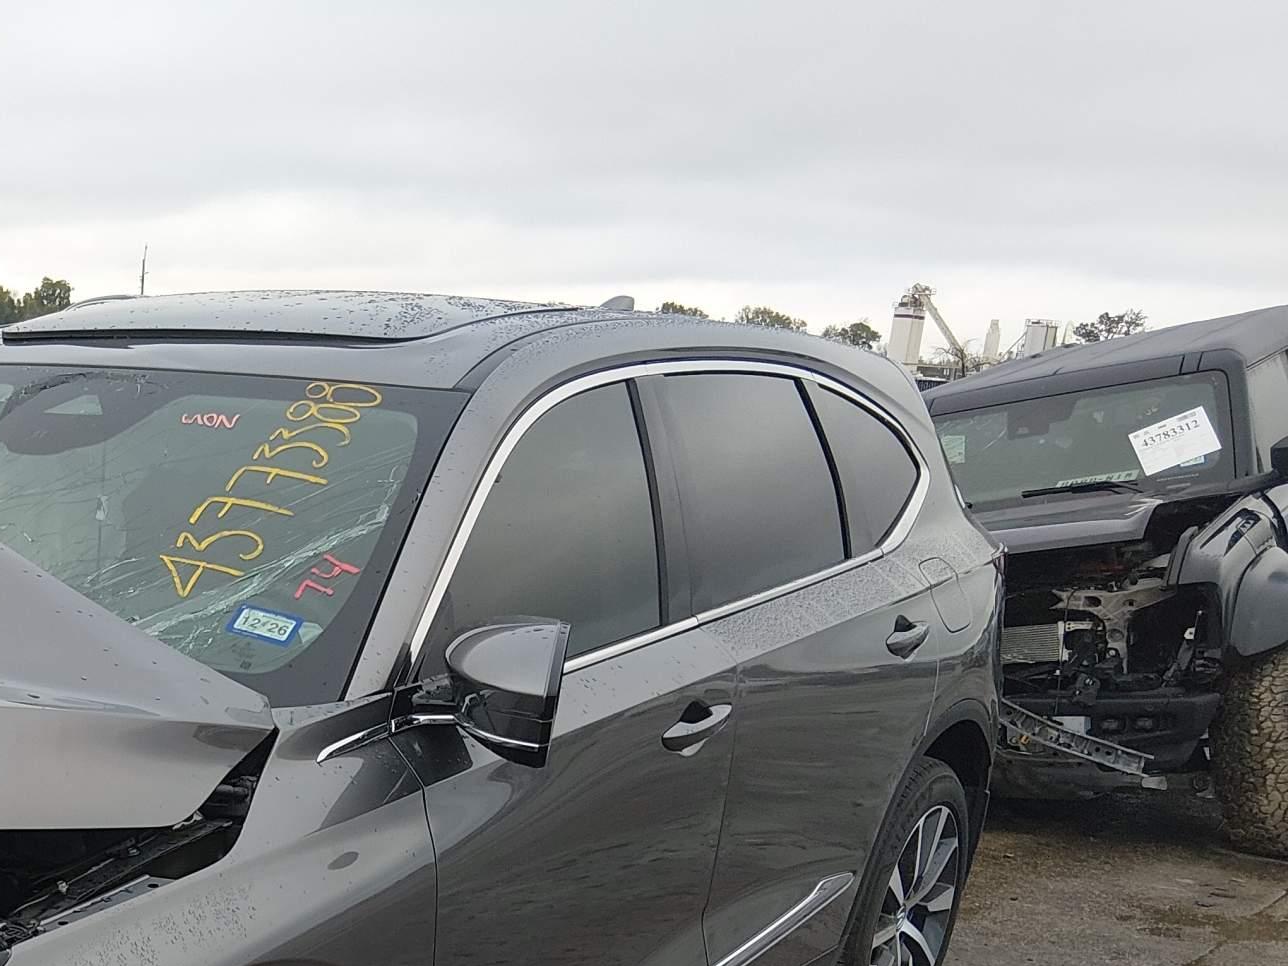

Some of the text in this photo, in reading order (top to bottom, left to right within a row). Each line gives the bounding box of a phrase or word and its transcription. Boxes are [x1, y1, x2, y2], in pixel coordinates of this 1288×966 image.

[1140, 418, 1201, 448] 43783312
[160, 382, 382, 598] 43773388
[294, 553, 360, 599] 74
